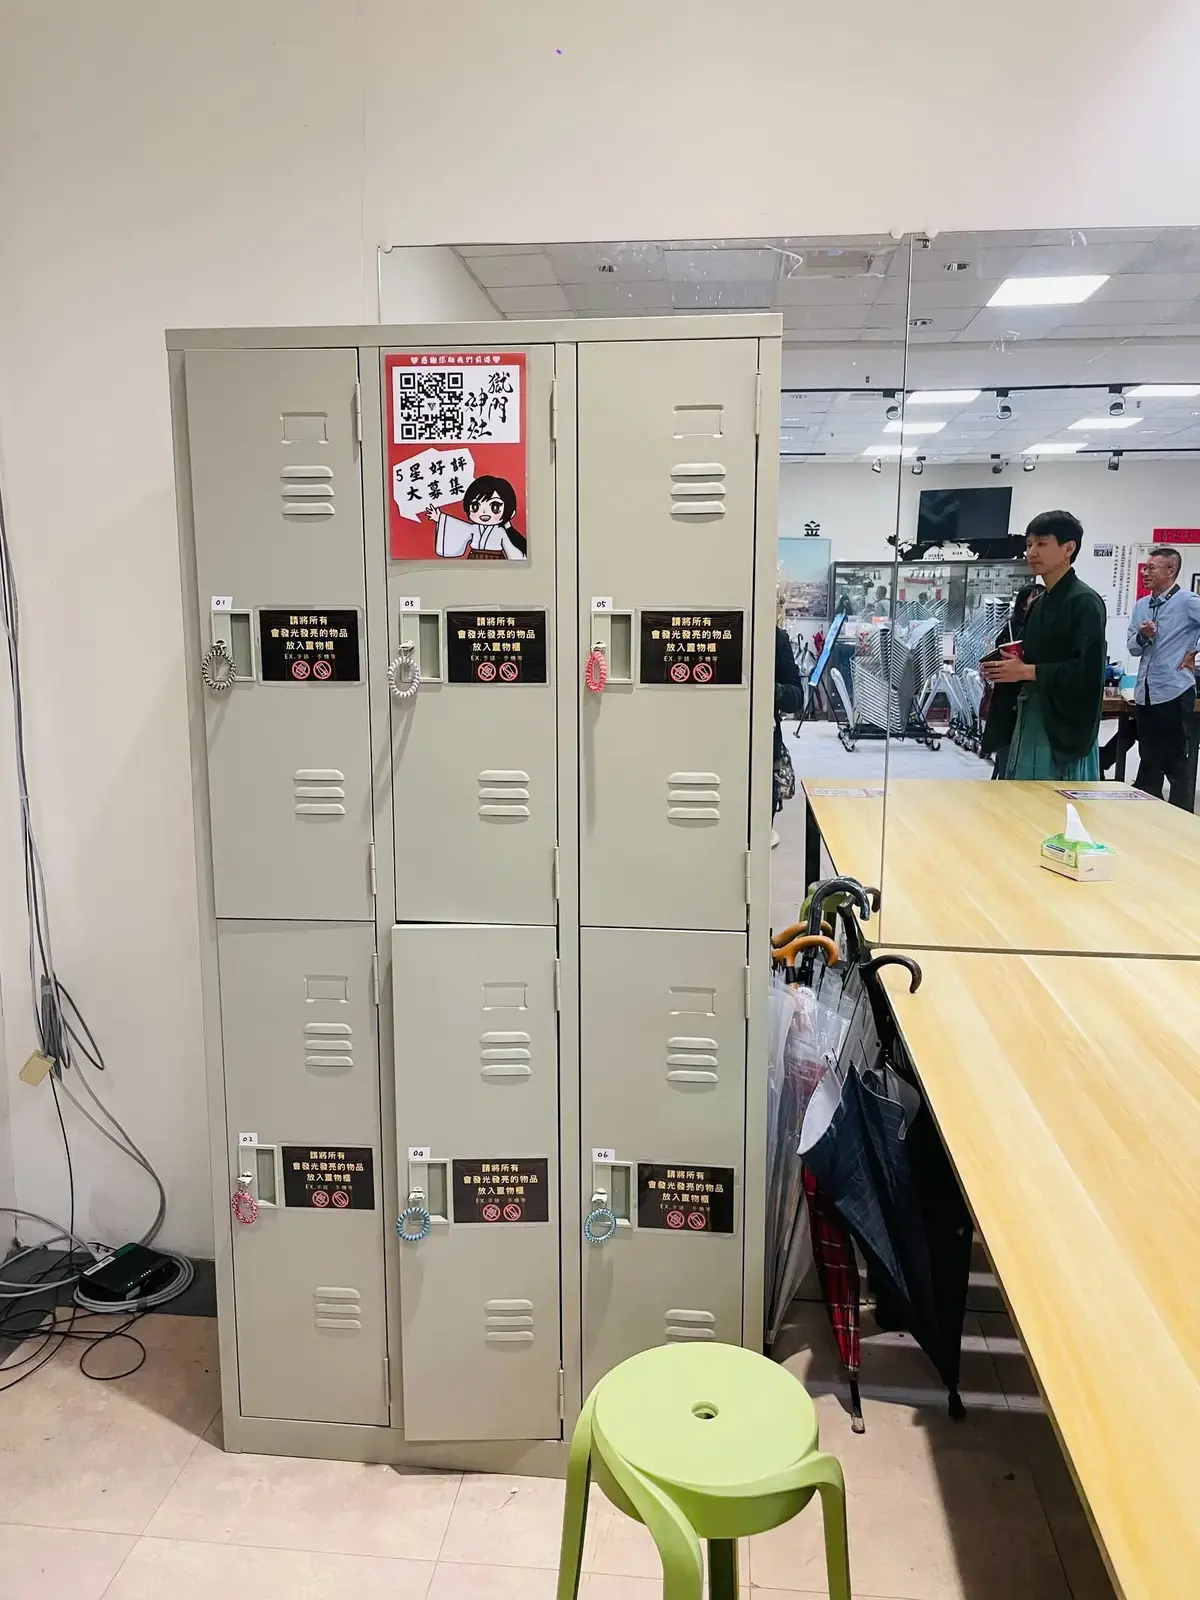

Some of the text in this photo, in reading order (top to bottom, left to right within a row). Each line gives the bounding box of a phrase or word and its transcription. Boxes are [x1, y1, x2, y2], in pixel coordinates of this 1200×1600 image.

[396, 457, 467, 482] 5星好評
[407, 476, 465, 502] 大募集
[289, 616, 328, 625] 請將所有
[476, 617, 515, 627] 請將所有
[672, 617, 712, 627] 請將所有
[270, 628, 348, 638] 會發光發亮的物品
[458, 630, 535, 639] 會發光發亮的物品
[651, 630, 732, 639] 會發光發亮的物品
[286, 641, 334, 650] 放入置物櫃
[472, 642, 521, 651] 放入置物櫃
[666, 643, 716, 652] 放入置物櫃
[309, 1151, 345, 1160] 請將所有
[293, 1162, 364, 1171] 會發光發亮的物品
[482, 1164, 519, 1172] 請將所有
[306, 1174, 352, 1182] 放入置物櫃
[667, 1170, 704, 1180] 請將所有
[463, 1176, 538, 1184] 會發光發亮的物品
[477, 1186, 524, 1195] 放入置物櫃
[648, 1180, 724, 1193] 會發光發亮的物品
[662, 1193, 709, 1203] 放入置物櫃
